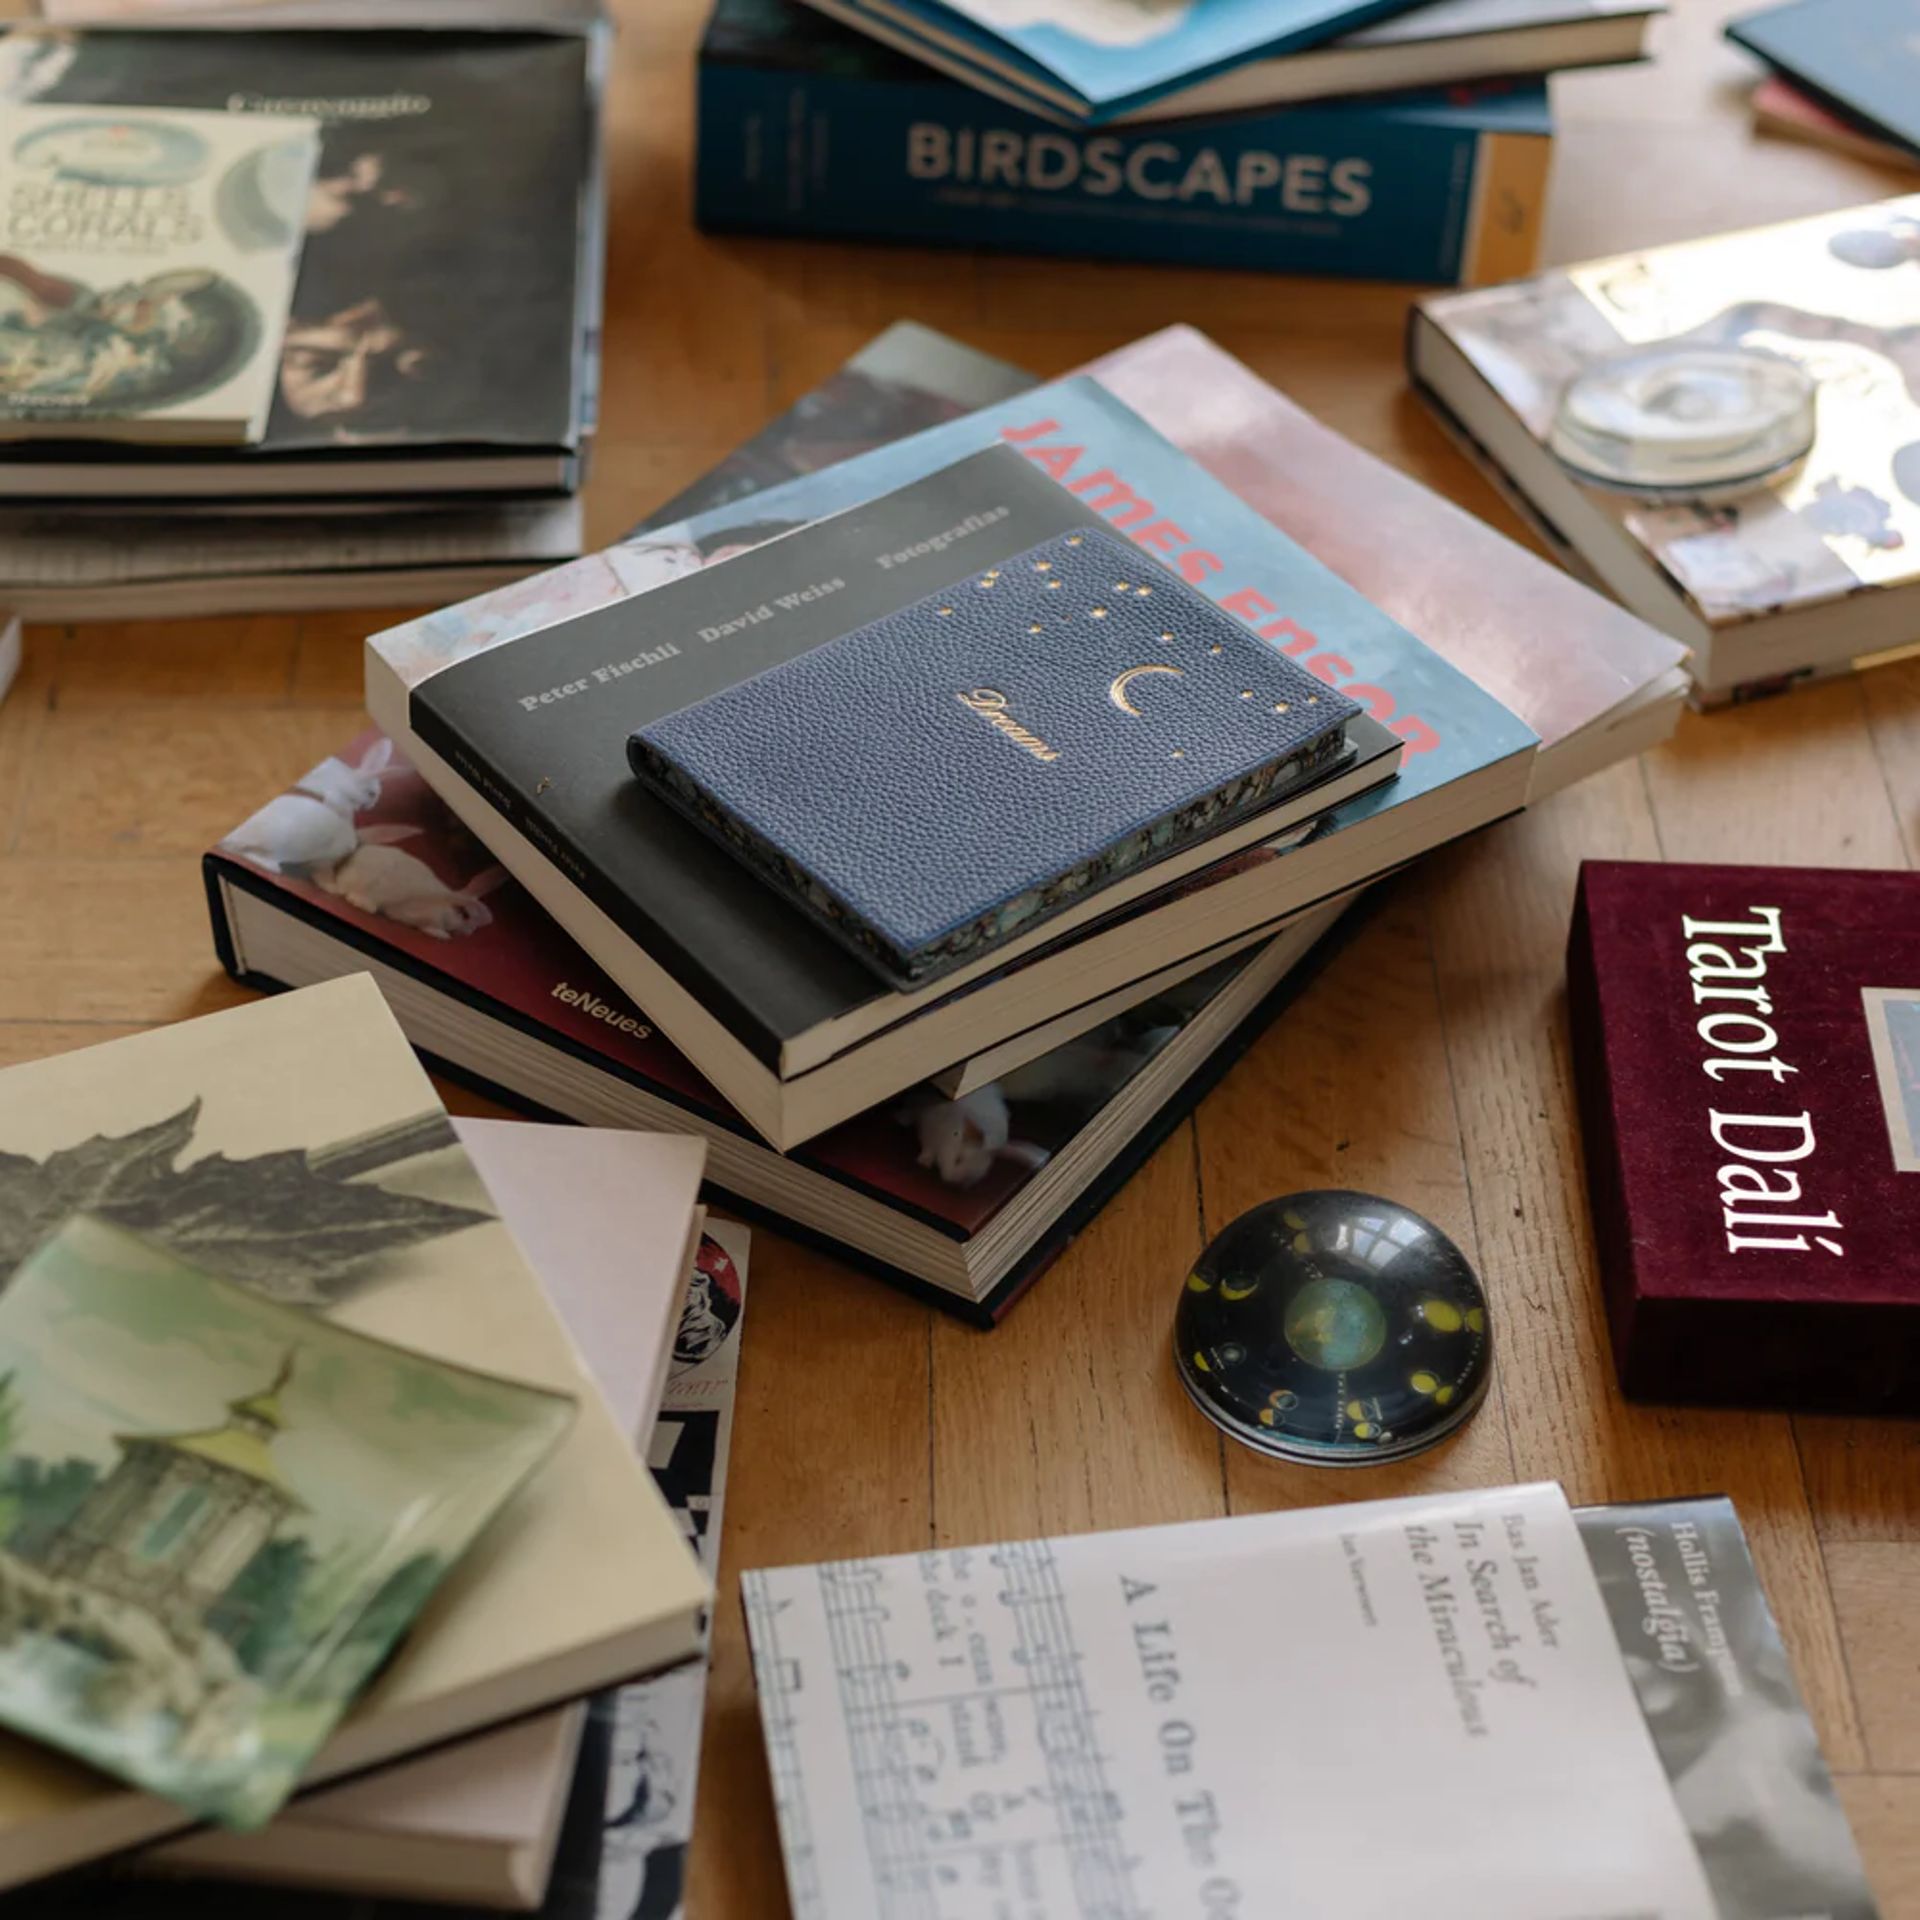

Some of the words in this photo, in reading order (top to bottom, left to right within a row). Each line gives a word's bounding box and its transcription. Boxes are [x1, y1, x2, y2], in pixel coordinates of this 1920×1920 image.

[906, 121, 1373, 216] BIRDSCAPES
[518, 678, 590, 712] Peter
[591, 641, 683, 684] Fischli
[696, 604, 774, 643] David
[775, 576, 847, 612] Weiss
[551, 982, 652, 1039] teNeues
[1681, 906, 1799, 1083] Tarot
[1708, 1107, 1845, 1256] Dalí
[1404, 1524, 1440, 1566] the
[1453, 1521, 1485, 1549] In
[1670, 1521, 1710, 1586] Hollis
[1119, 1574, 1158, 1606] A
[1465, 1559, 1522, 1650] Search
[1511, 1555, 1540, 1591] Jan
[1132, 1619, 1182, 1704] Life
[1417, 1572, 1489, 1738] Miraculous
[1487, 1658, 1539, 1690] of
[1158, 1718, 1198, 1776] On
[1173, 1789, 1222, 1869] The
